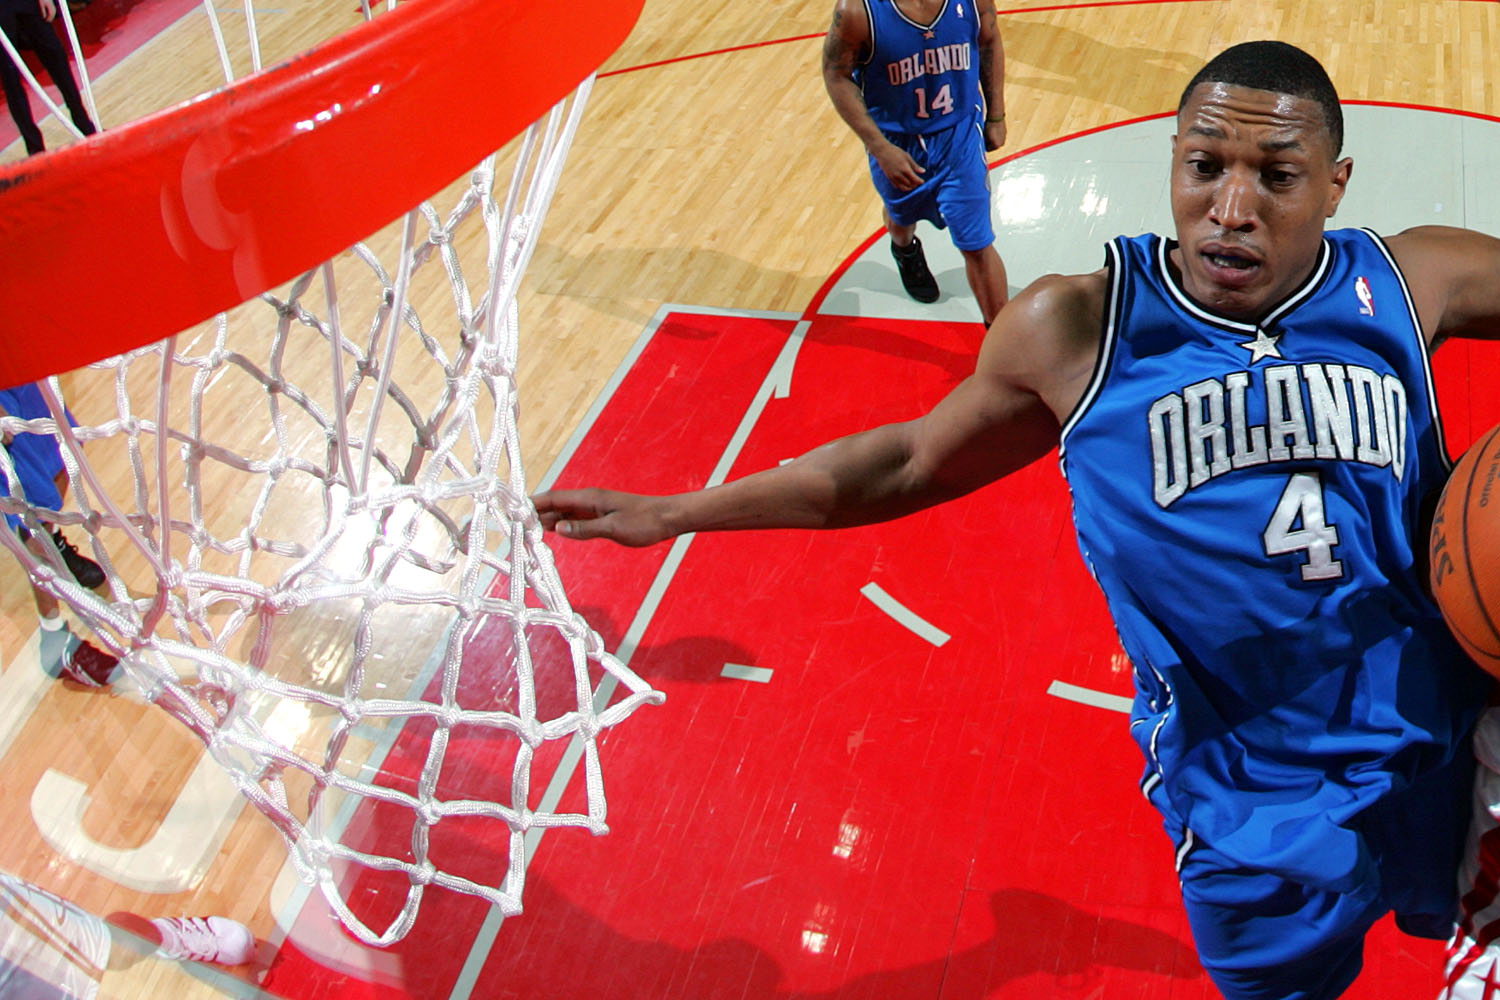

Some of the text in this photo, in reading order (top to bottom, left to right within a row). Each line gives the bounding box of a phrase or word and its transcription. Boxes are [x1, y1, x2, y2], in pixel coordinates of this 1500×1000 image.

[886, 42, 971, 86] ORLANDO
[914, 84, 954, 119] 14
[1147, 362, 1408, 510] ORLANDO
[1479, 462, 1500, 508] Official
[1262, 470, 1345, 583] 4
